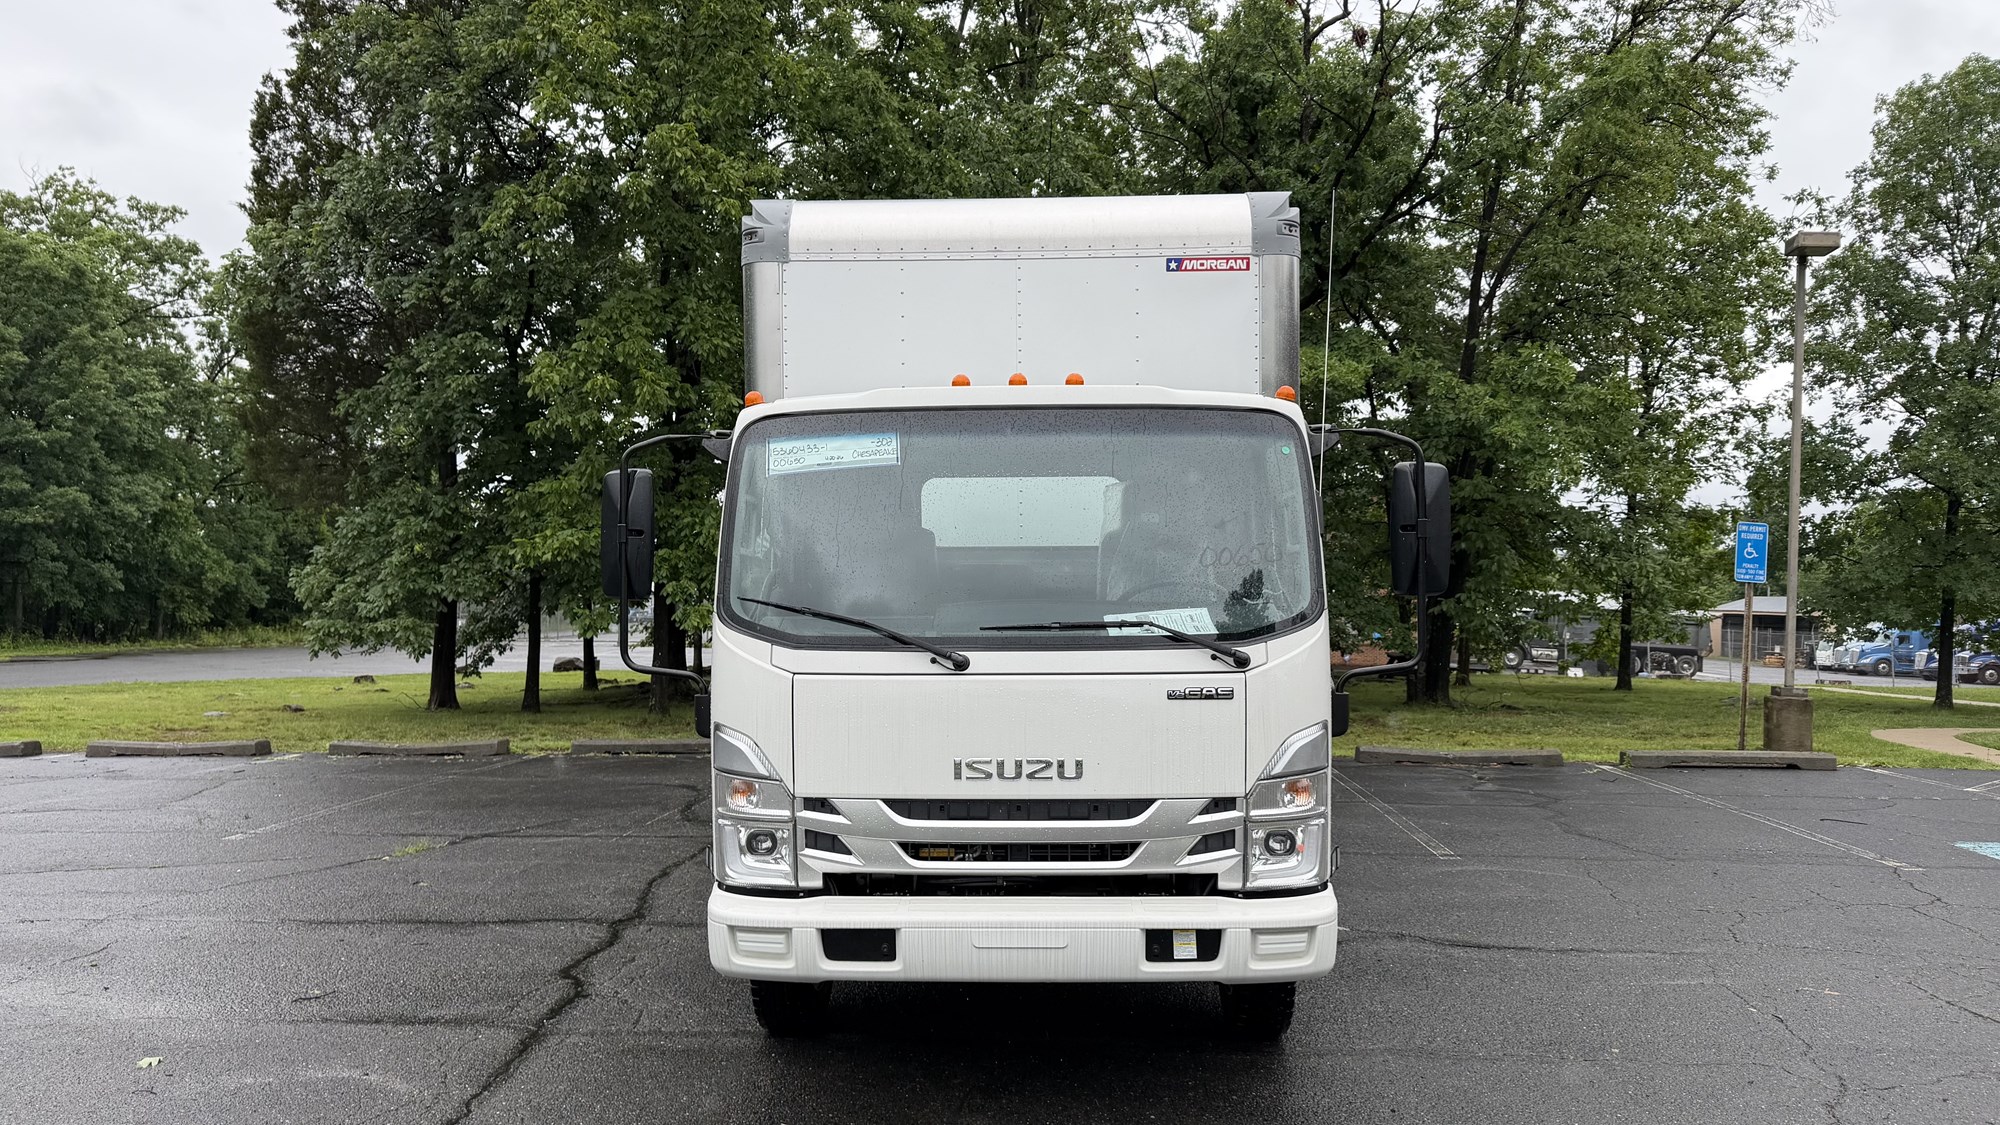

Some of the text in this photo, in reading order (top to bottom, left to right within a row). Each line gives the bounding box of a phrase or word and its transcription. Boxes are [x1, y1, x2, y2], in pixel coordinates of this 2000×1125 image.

[1181, 259, 1247, 270] MORGAN
[772, 457, 806, 467] 00650
[1185, 687, 1234, 699] GAS
[953, 757, 1083, 780] ISUZU
